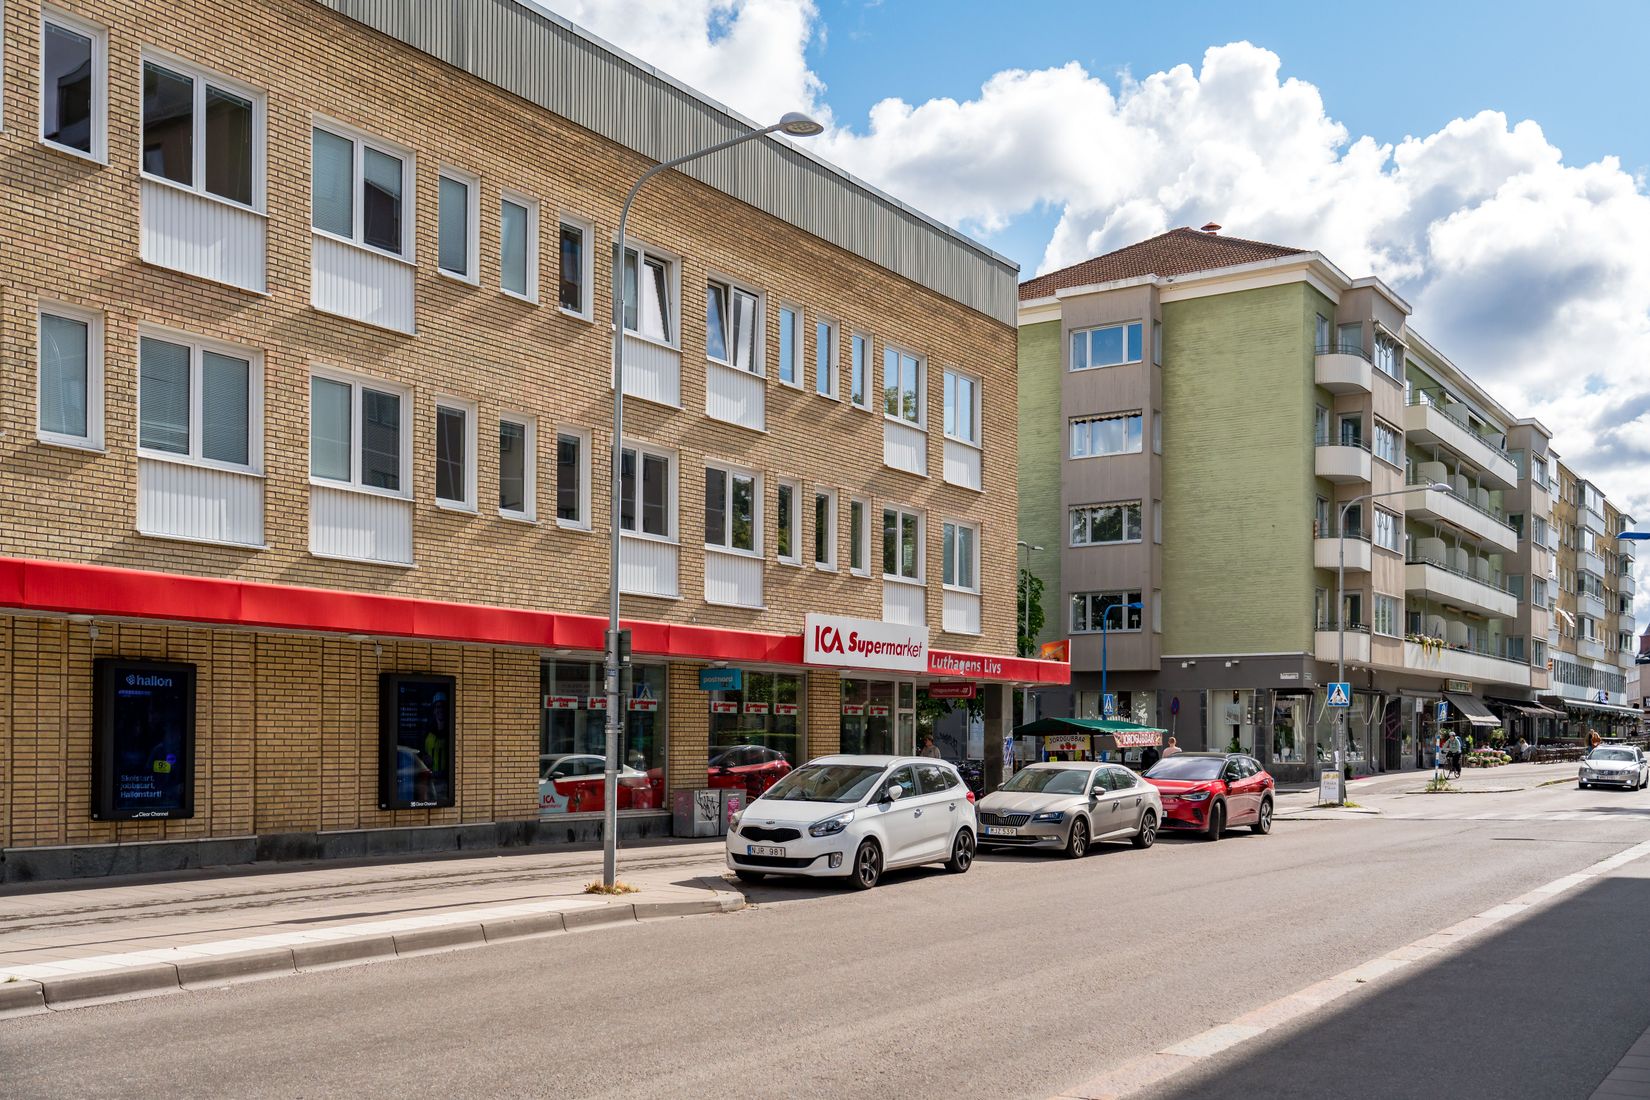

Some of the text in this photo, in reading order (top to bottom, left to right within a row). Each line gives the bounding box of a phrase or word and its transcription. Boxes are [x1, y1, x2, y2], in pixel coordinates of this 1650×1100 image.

[814, 625, 922, 658] ICA Supermarket
[931, 654, 1002, 676] Luthagens Livs
[136, 674, 173, 688] hallon
[703, 675, 734, 684] postnord
[1048, 735, 1086, 745] JORDGUBBAR
[1122, 733, 1155, 745] JORDGUBBAR
[120, 774, 156, 782] Skolstart,
[119, 782, 156, 791] jobbstart,
[120, 790, 162, 799] Hallonstart!
[543, 794, 556, 803] ICA
[751, 847, 784, 856] NJR 981
